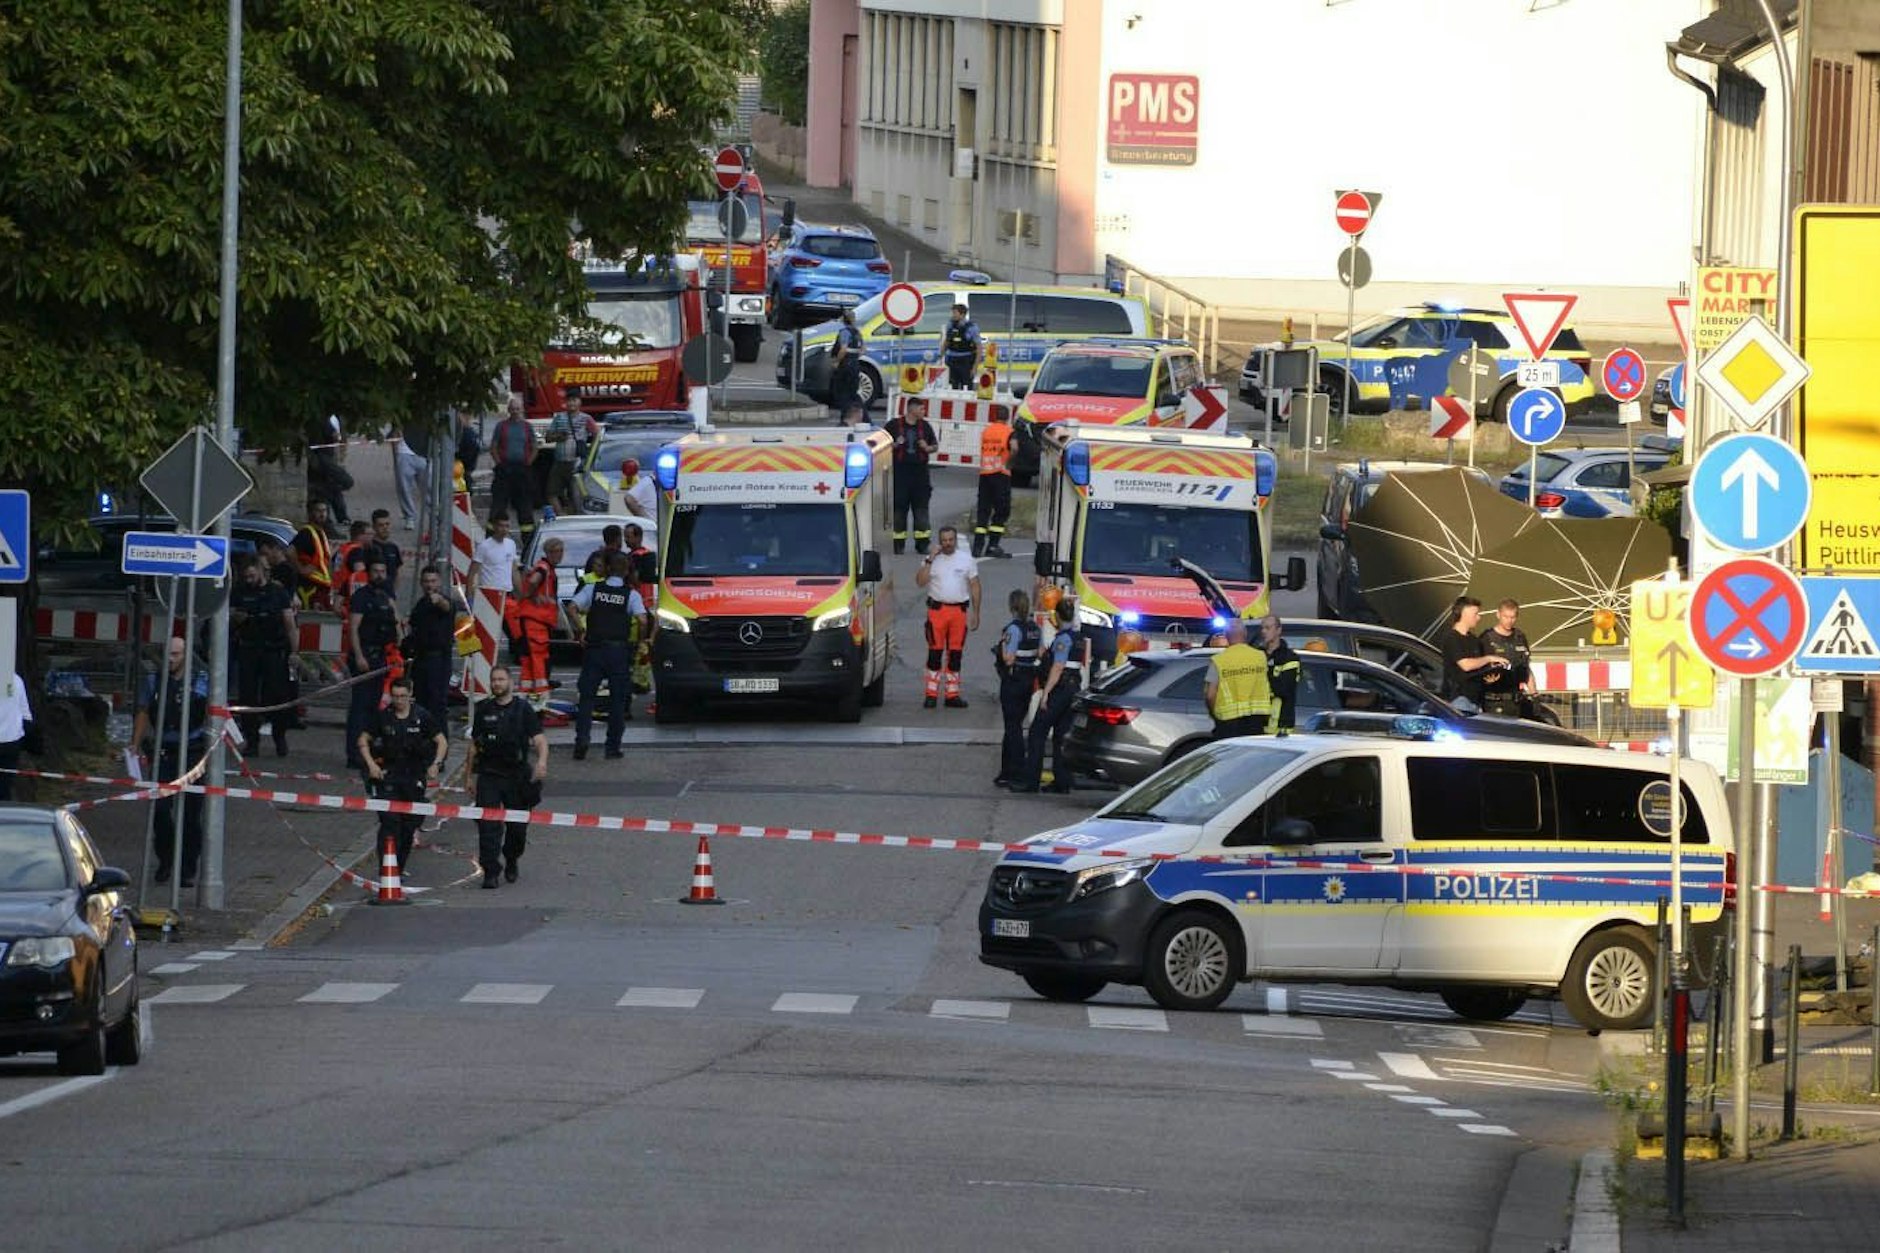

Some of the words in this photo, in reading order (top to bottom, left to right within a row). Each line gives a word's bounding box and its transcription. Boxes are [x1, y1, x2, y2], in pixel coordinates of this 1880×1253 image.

[1112, 81, 1195, 124] PMS
[1703, 271, 1776, 294] CITY
[1702, 297, 1777, 314] MART
[553, 365, 659, 384] FEUERWEHR
[1525, 368, 1539, 382] 25
[1542, 370, 1552, 382] m
[579, 384, 632, 396] IVECO
[1040, 403, 1118, 414] NOTARZT
[688, 484, 743, 494] Deutsches
[745, 483, 775, 492] Rotes
[778, 483, 809, 492] Kreuz
[1114, 479, 1173, 488] FEUERWEHR
[1176, 482, 1219, 496] 112
[130, 547, 198, 561] Einbahnstraße
[595, 591, 625, 605] POLIZEI
[690, 588, 815, 601] RETTUNGSDIENST
[1434, 875, 1540, 899] POLIZEI
